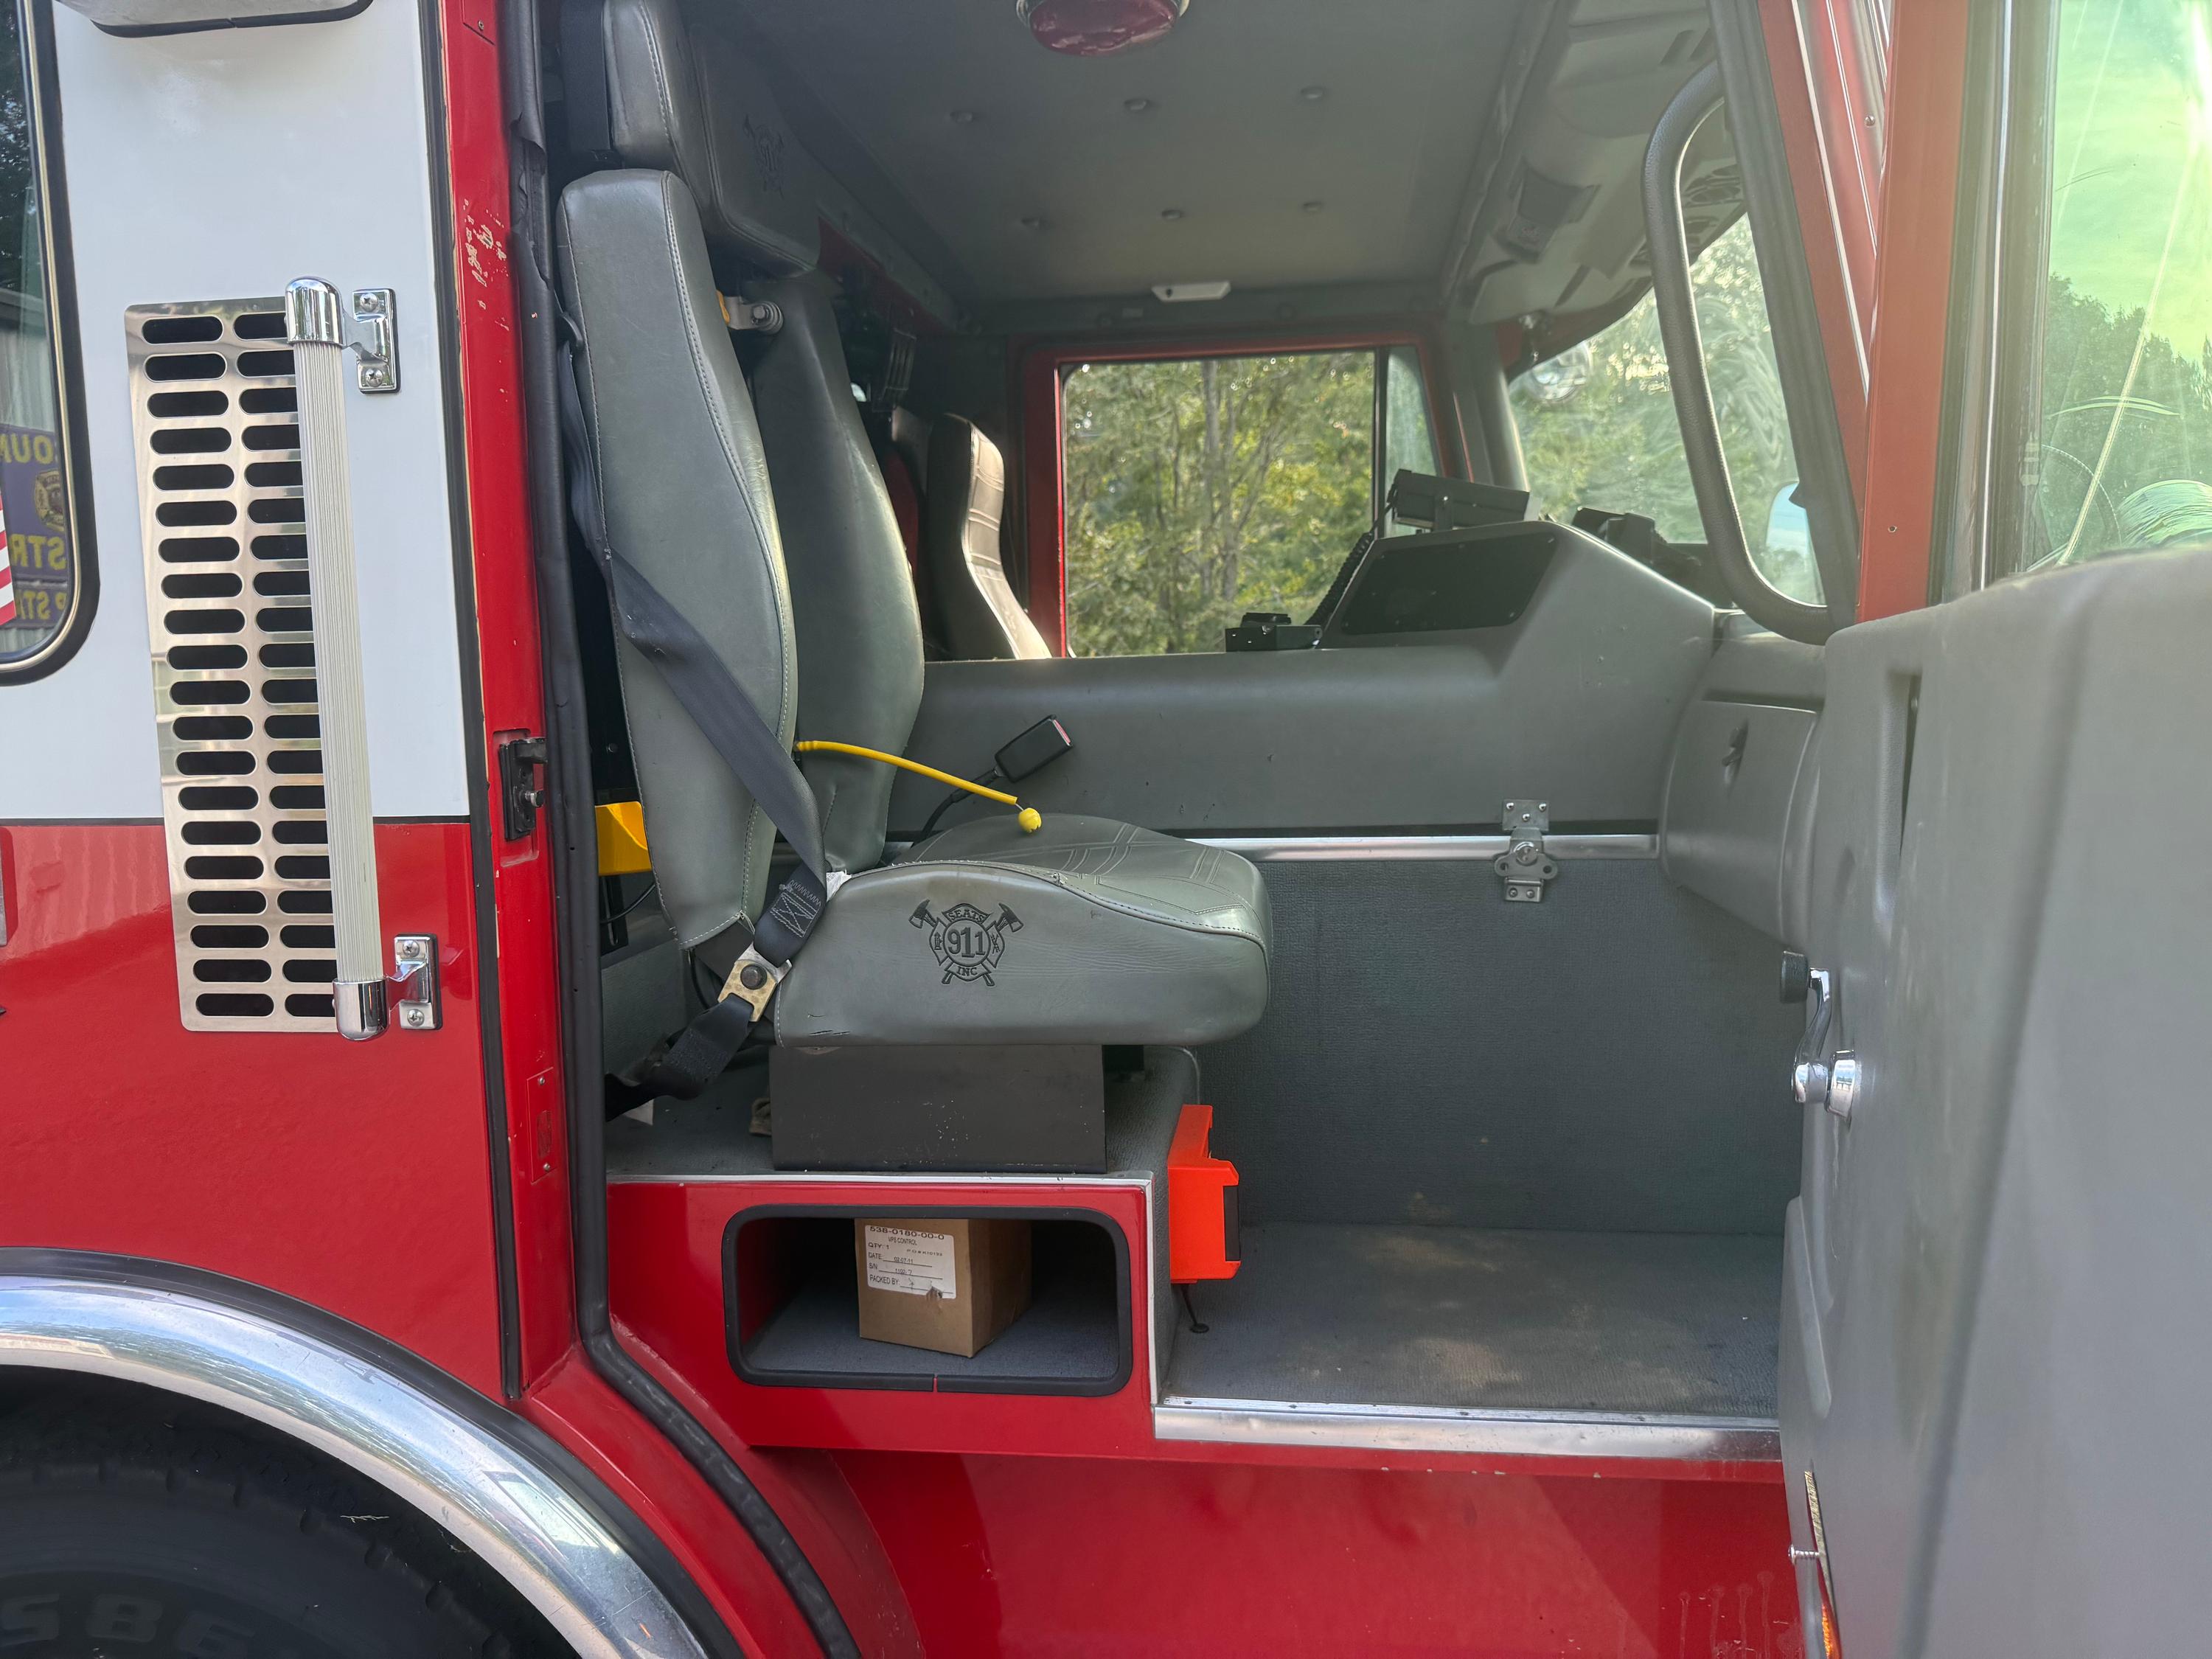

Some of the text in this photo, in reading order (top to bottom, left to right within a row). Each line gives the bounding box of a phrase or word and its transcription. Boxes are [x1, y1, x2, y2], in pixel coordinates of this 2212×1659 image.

[948, 908, 984, 924] SEATS
[947, 927, 986, 958] 911
[956, 966, 978, 976] INC
[869, 1274, 891, 1284] PACKED
